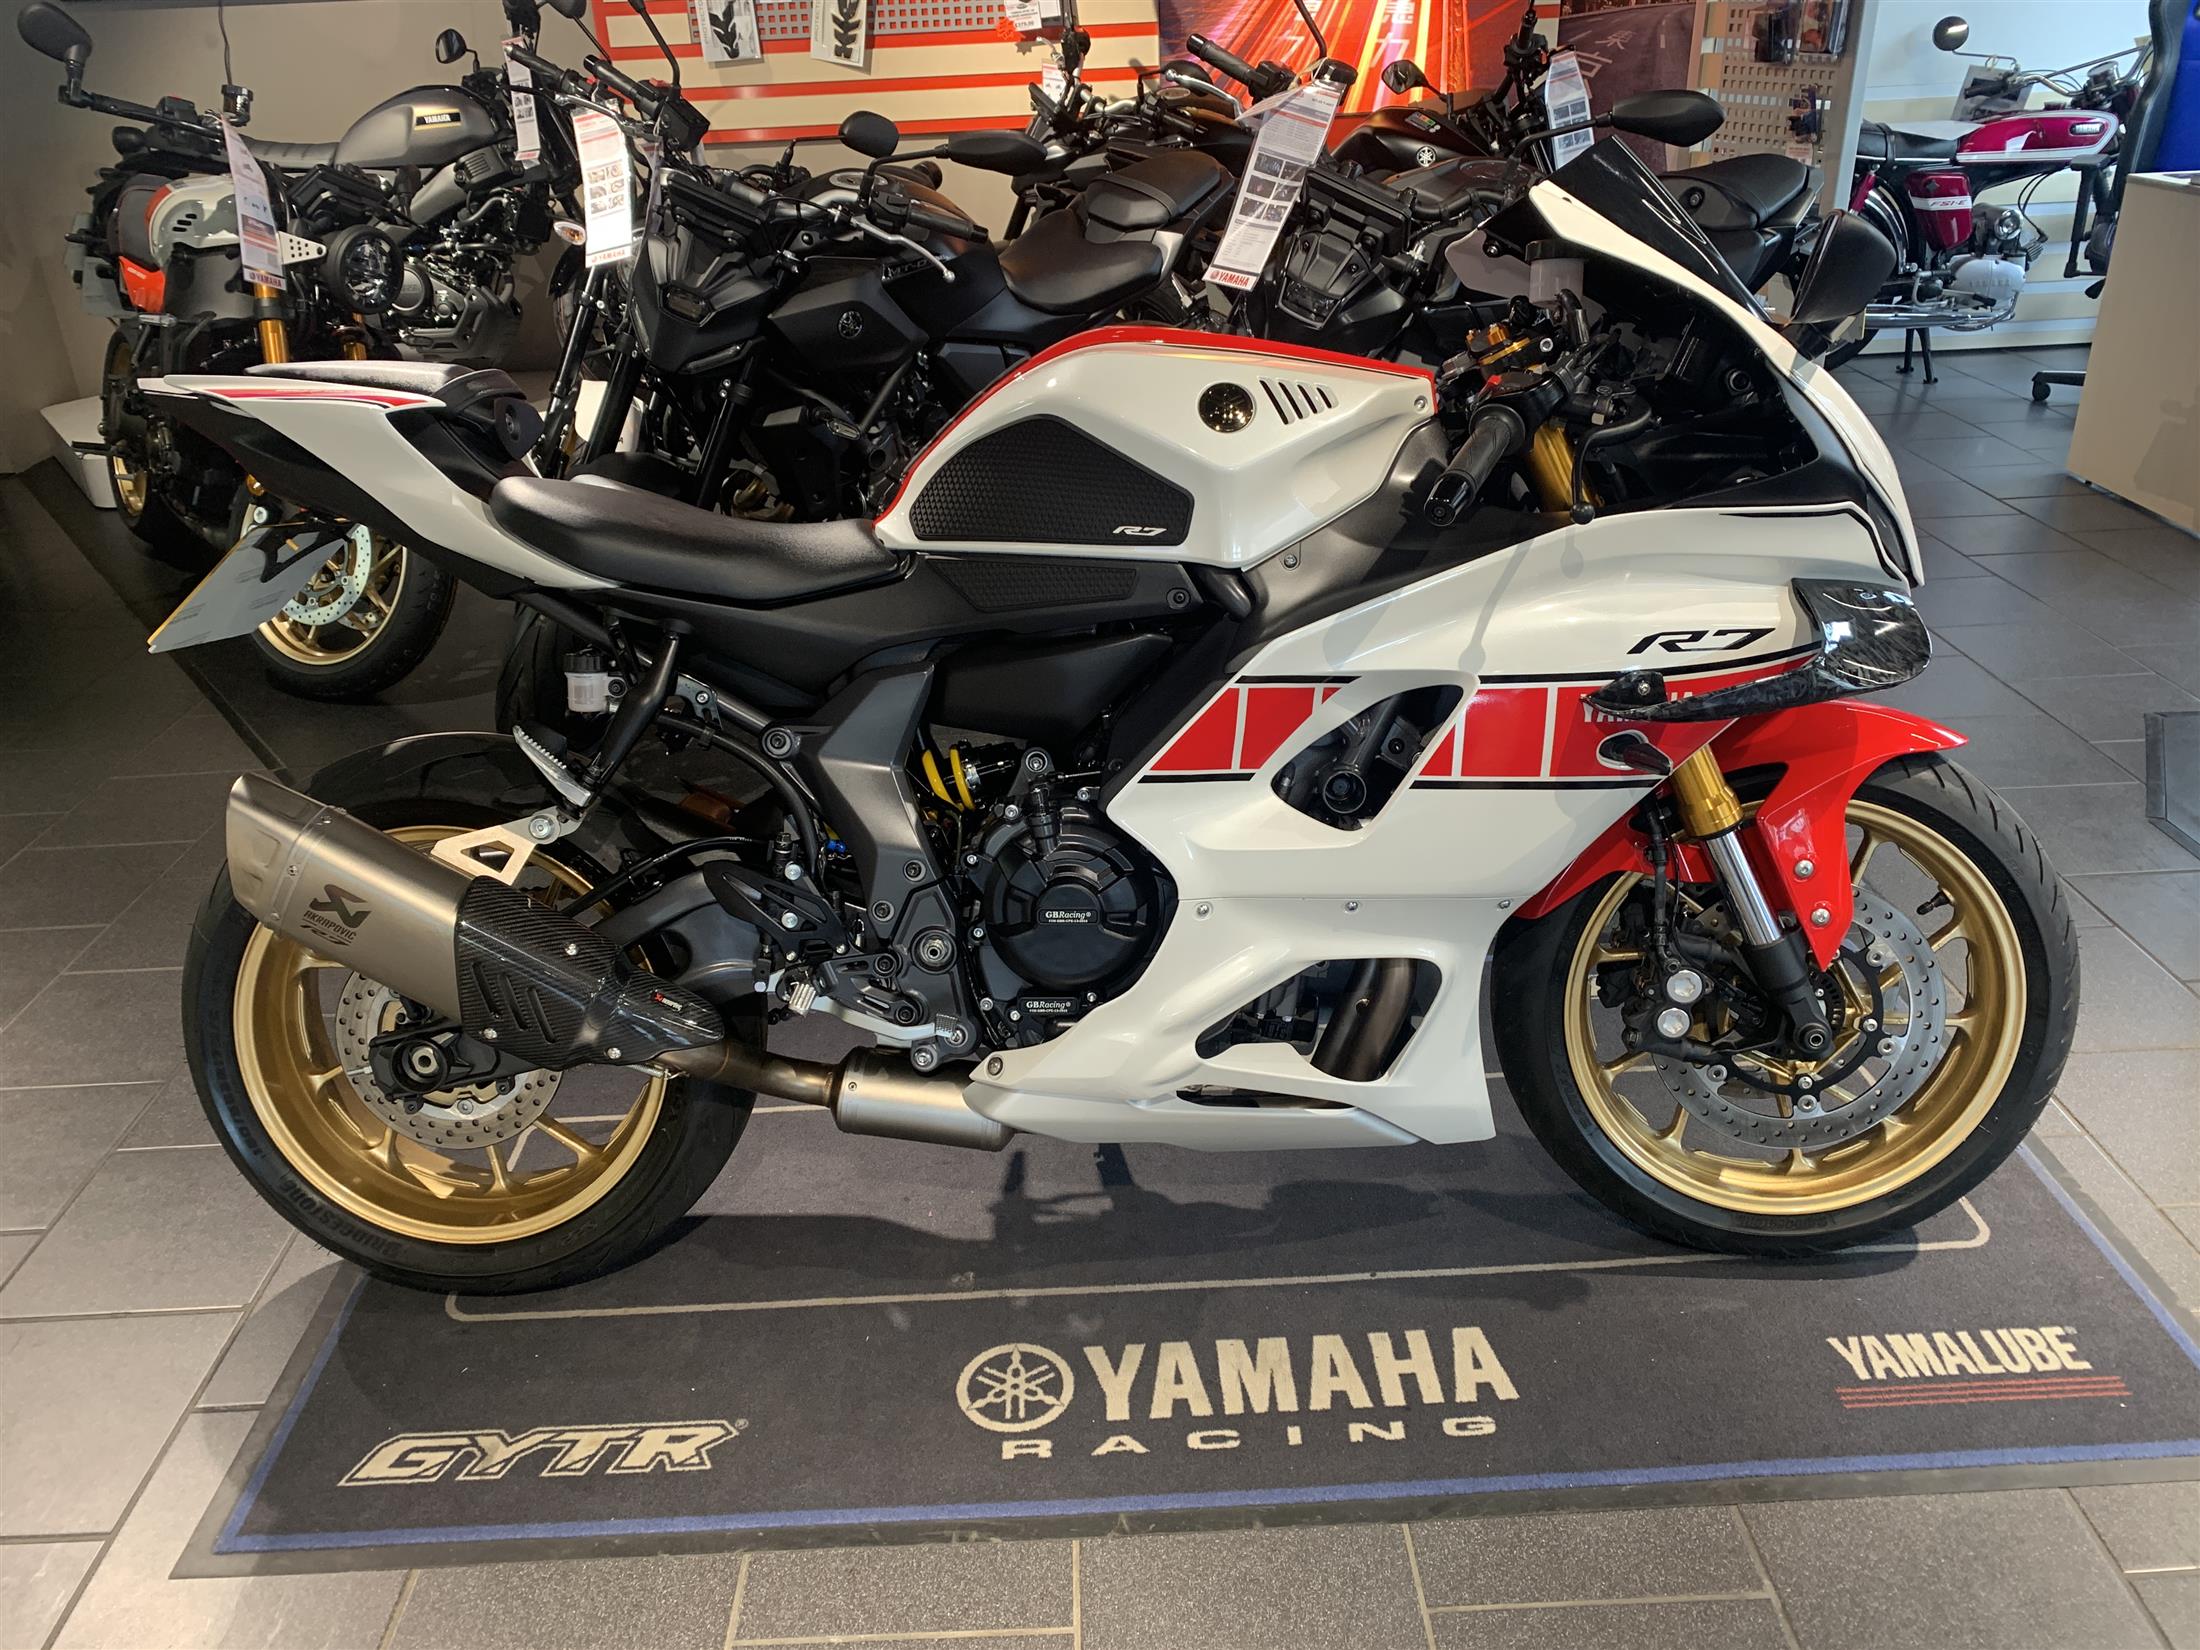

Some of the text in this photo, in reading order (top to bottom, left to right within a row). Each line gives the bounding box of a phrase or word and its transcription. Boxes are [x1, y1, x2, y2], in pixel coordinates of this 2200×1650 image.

[424, 114, 452, 124] YAMAHA
[1219, 271, 1251, 288] YAMAHA
[1112, 525, 1168, 537] R7
[1626, 627, 1776, 655] R7
[1825, 1326, 2093, 1381] YAMALUBE
[1083, 1326, 1521, 1422] YAMAHA
[337, 1420, 740, 1487] GYTR
[1001, 1416, 1497, 1460] RACING
